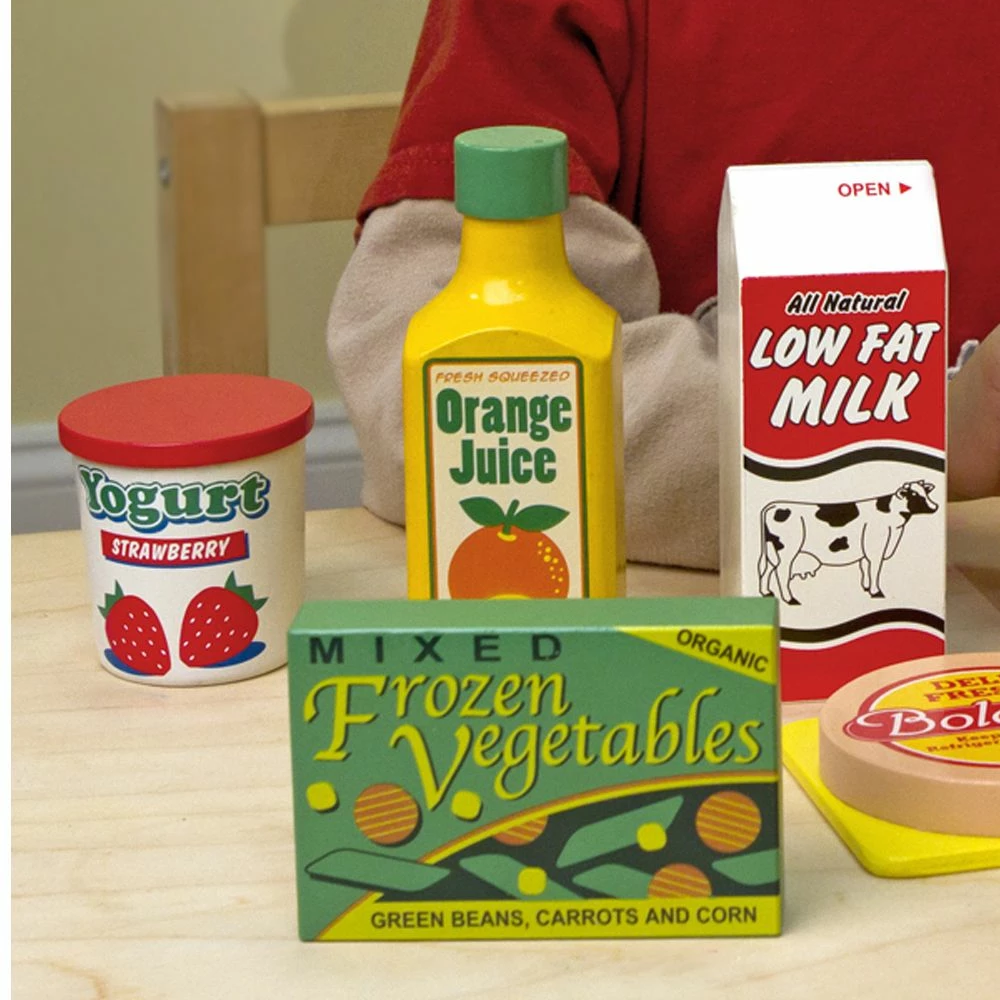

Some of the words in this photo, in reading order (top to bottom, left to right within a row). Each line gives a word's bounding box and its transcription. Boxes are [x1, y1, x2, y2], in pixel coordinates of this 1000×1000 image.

[837, 182, 890, 197] OPEN
[786, 292, 821, 315] All
[821, 288, 909, 314] Natural
[749, 324, 852, 369] LOW
[856, 321, 942, 364] FAT
[435, 372, 483, 383] FRESH
[488, 371, 570, 383] SQUEEZED
[769, 370, 921, 428] MILK
[436, 388, 572, 442] Orange
[449, 437, 557, 485] Juice
[79, 465, 270, 532] Yogurt
[111, 536, 231, 561] STRAWBERRY
[309, 634, 562, 664] MIXED
[676, 628, 769, 674] ORGANIC
[303, 671, 572, 762] Frozen
[389, 686, 765, 812] Vegetables
[370, 910, 444, 930] GREEN
[451, 909, 530, 930] BEANS,
[535, 907, 639, 928] CARROTS
[645, 906, 690, 925] AND
[696, 904, 758, 923] CORN
